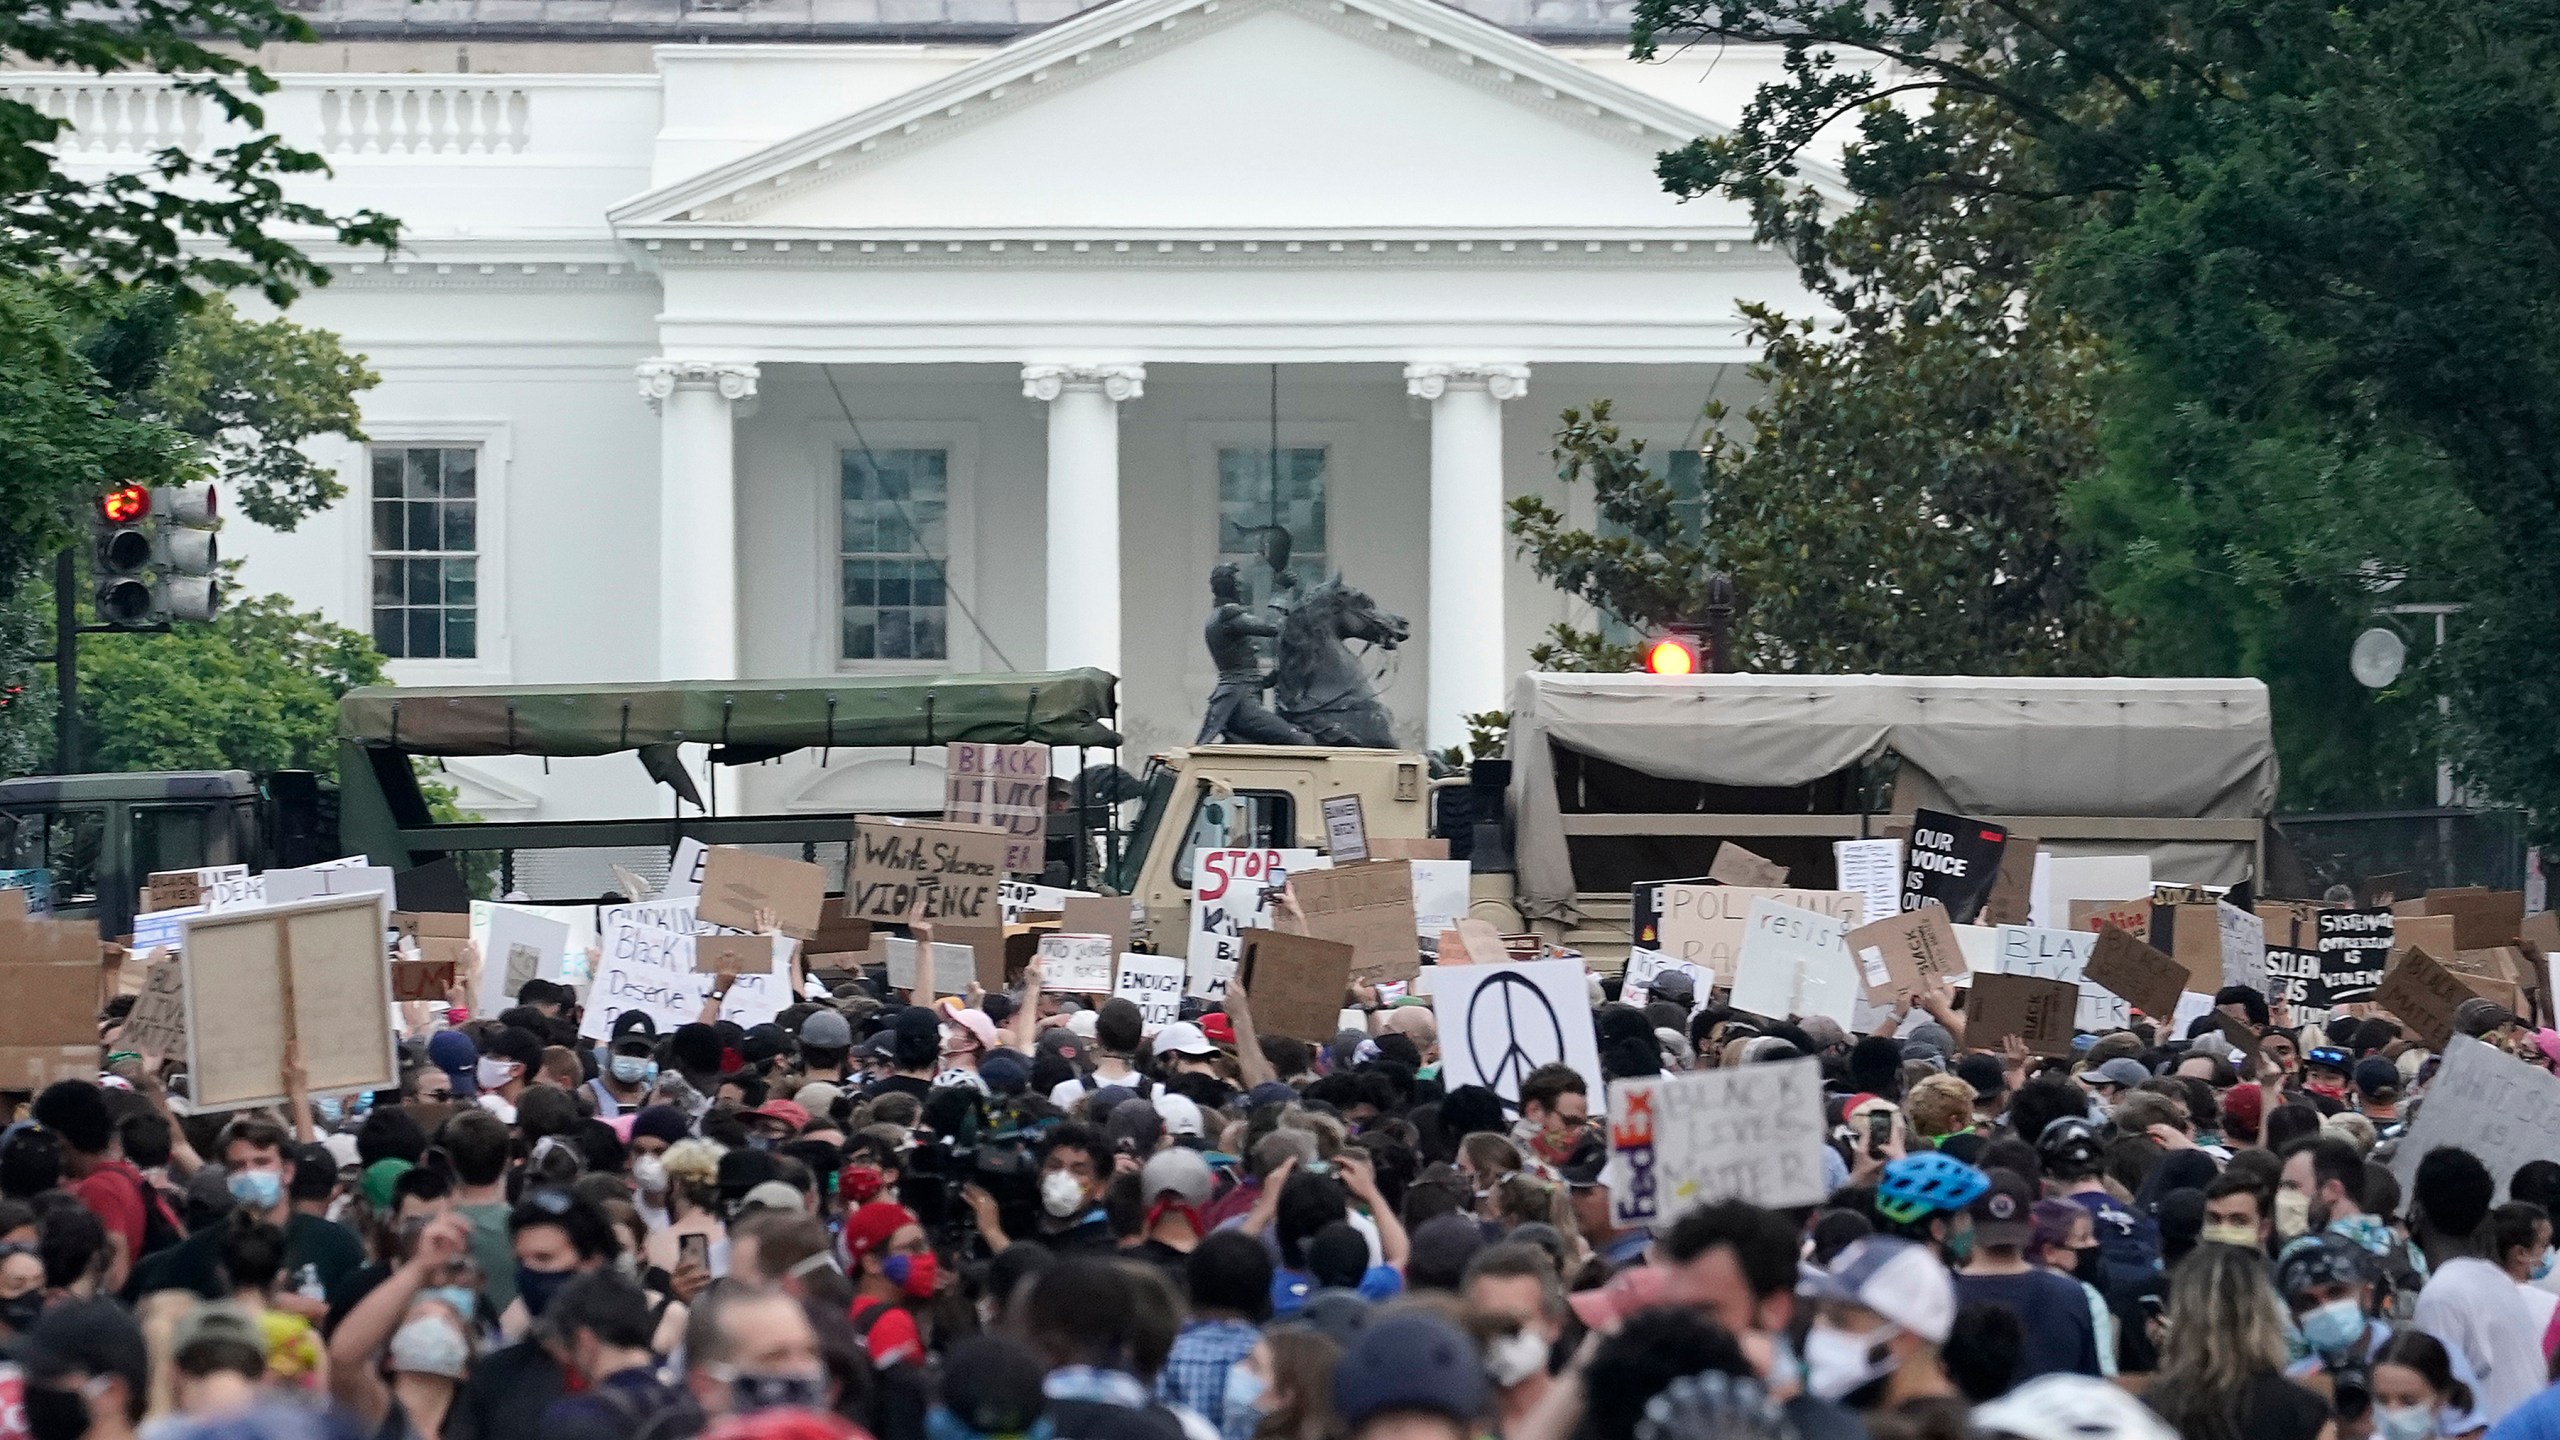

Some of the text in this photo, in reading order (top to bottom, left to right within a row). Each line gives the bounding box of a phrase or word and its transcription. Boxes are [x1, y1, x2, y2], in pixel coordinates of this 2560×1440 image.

[959, 746, 1038, 774] BLACK
[952, 779, 1044, 836] LIVES
[863, 832, 928, 872] White
[1914, 828, 1954, 852] OUR
[1198, 849, 1281, 901] STOP
[1911, 849, 1968, 877] VOICE
[1905, 871, 1925, 890] IS
[854, 880, 990, 918] VIOLENCE
[1760, 911, 1849, 952] resist
[2090, 911, 2146, 931] Plice
[2343, 950, 2362, 964] IS
[609, 969, 685, 1010] Deserve
[1122, 971, 1178, 991] ENOUGH
[2286, 979, 2309, 1001] IS
[1686, 1104, 1815, 1149] LIVES
[1613, 1087, 1657, 1220] FedEx
